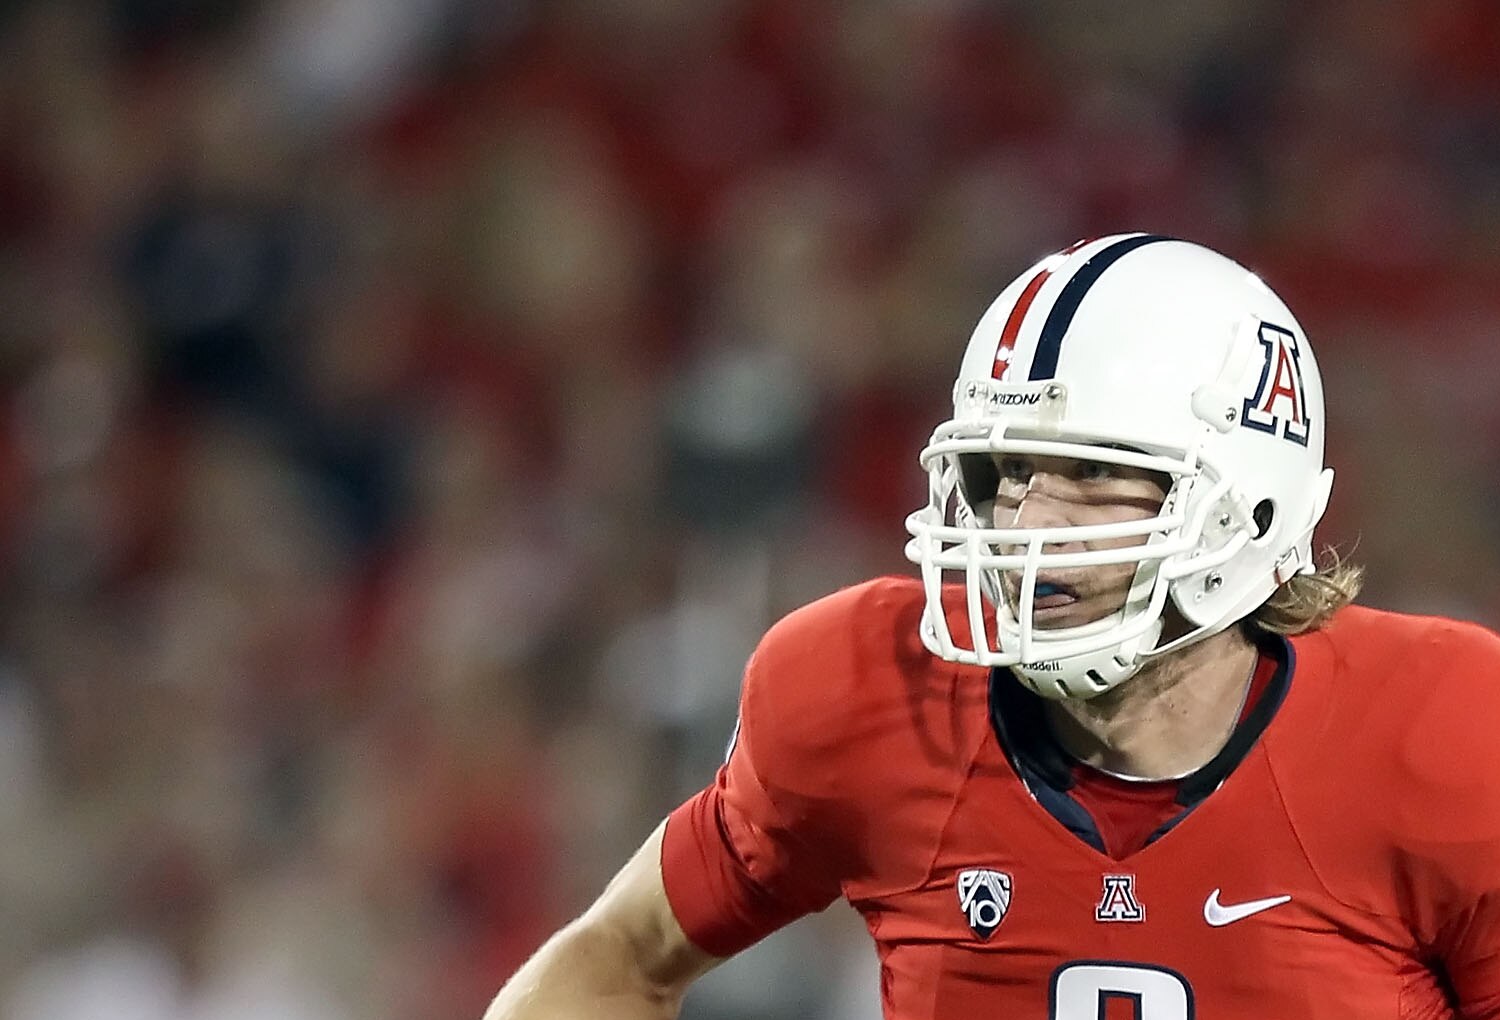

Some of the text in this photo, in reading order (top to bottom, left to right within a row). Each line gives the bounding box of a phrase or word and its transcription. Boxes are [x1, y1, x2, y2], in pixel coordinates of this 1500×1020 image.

[1241, 321, 1311, 447] A
[957, 869, 1011, 915] PAC
[970, 899, 1001, 927] 10
[1095, 873, 1145, 923] A
